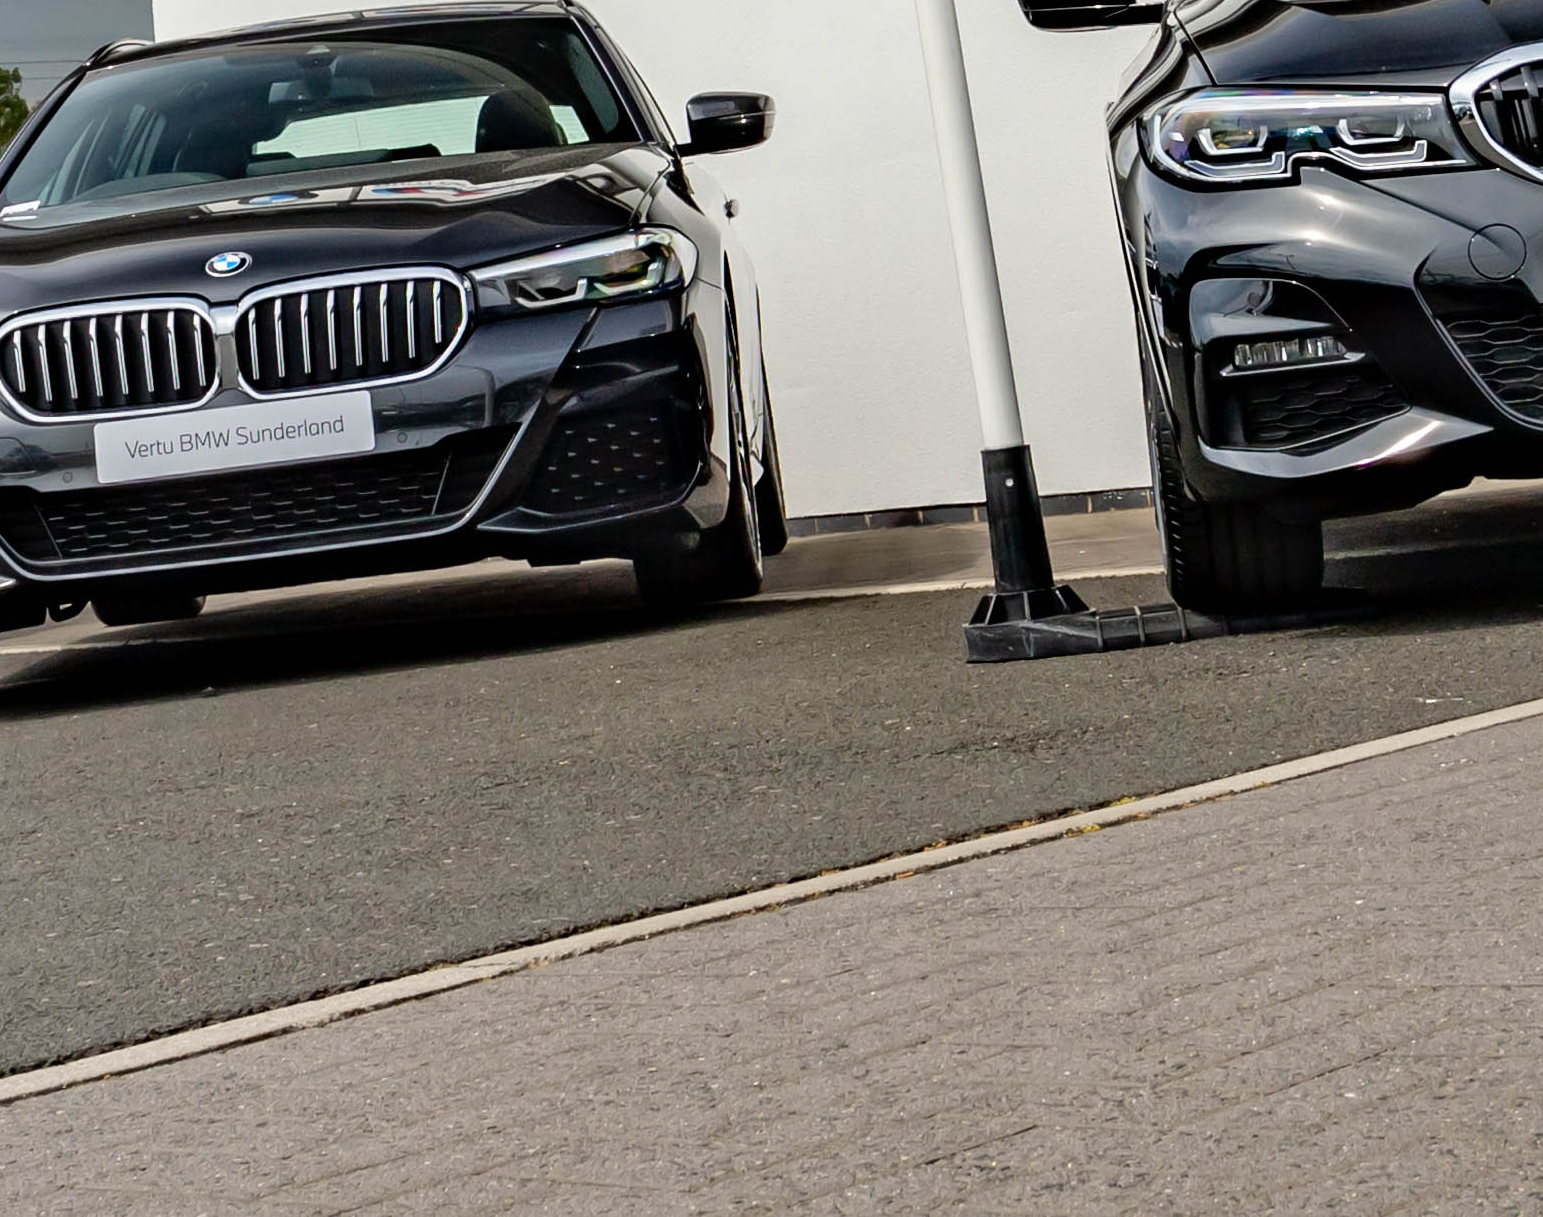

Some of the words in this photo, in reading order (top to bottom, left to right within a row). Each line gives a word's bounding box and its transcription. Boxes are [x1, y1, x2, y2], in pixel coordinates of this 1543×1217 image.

[124, 438, 173, 459] Vertu
[179, 428, 230, 453] BMW
[236, 414, 345, 446] Sunderland
